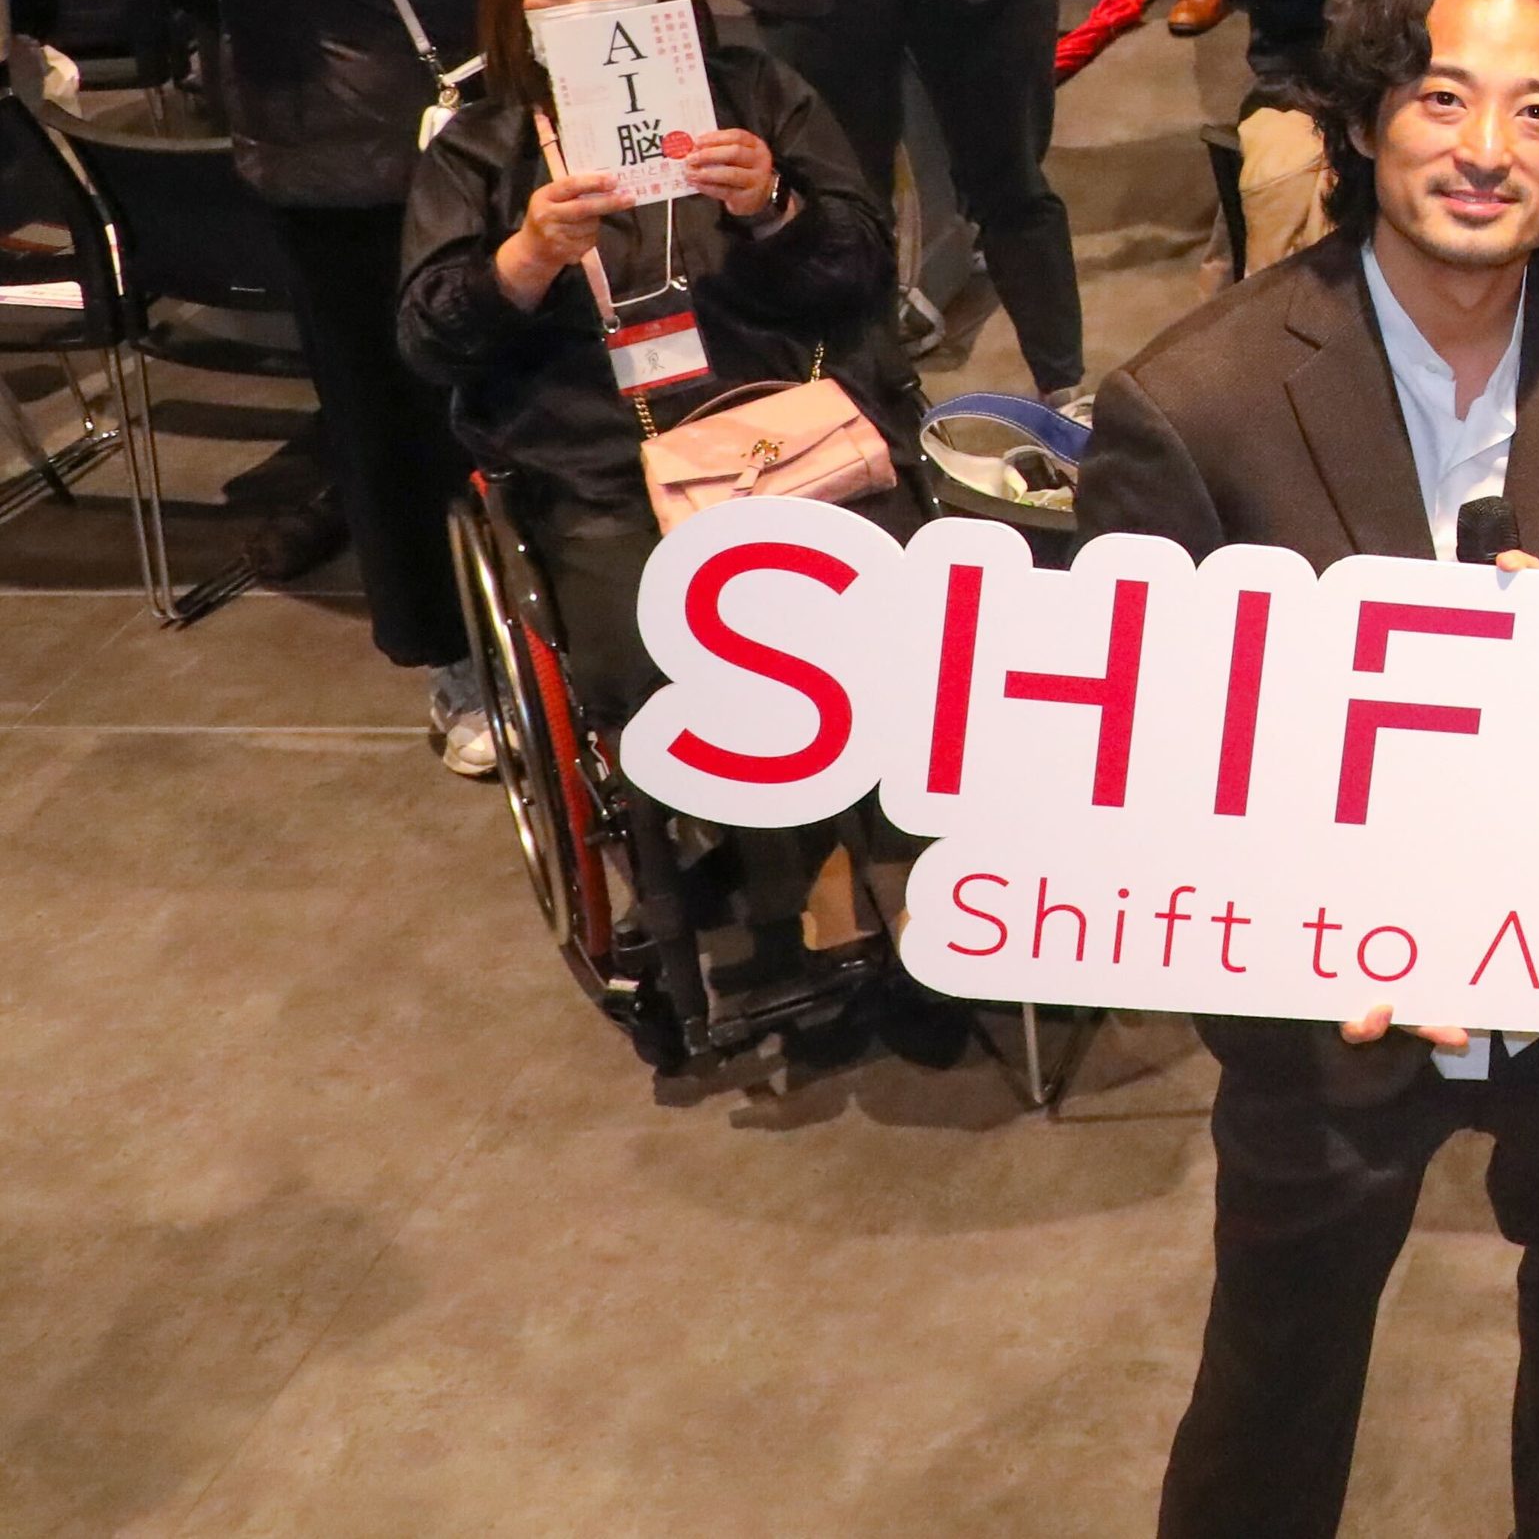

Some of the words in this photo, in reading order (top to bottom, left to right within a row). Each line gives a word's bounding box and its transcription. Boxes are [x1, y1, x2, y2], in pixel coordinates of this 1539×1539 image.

[603, 20, 664, 166] AI脳
[946, 871, 1253, 975] Shift
[1301, 906, 1420, 983] to
